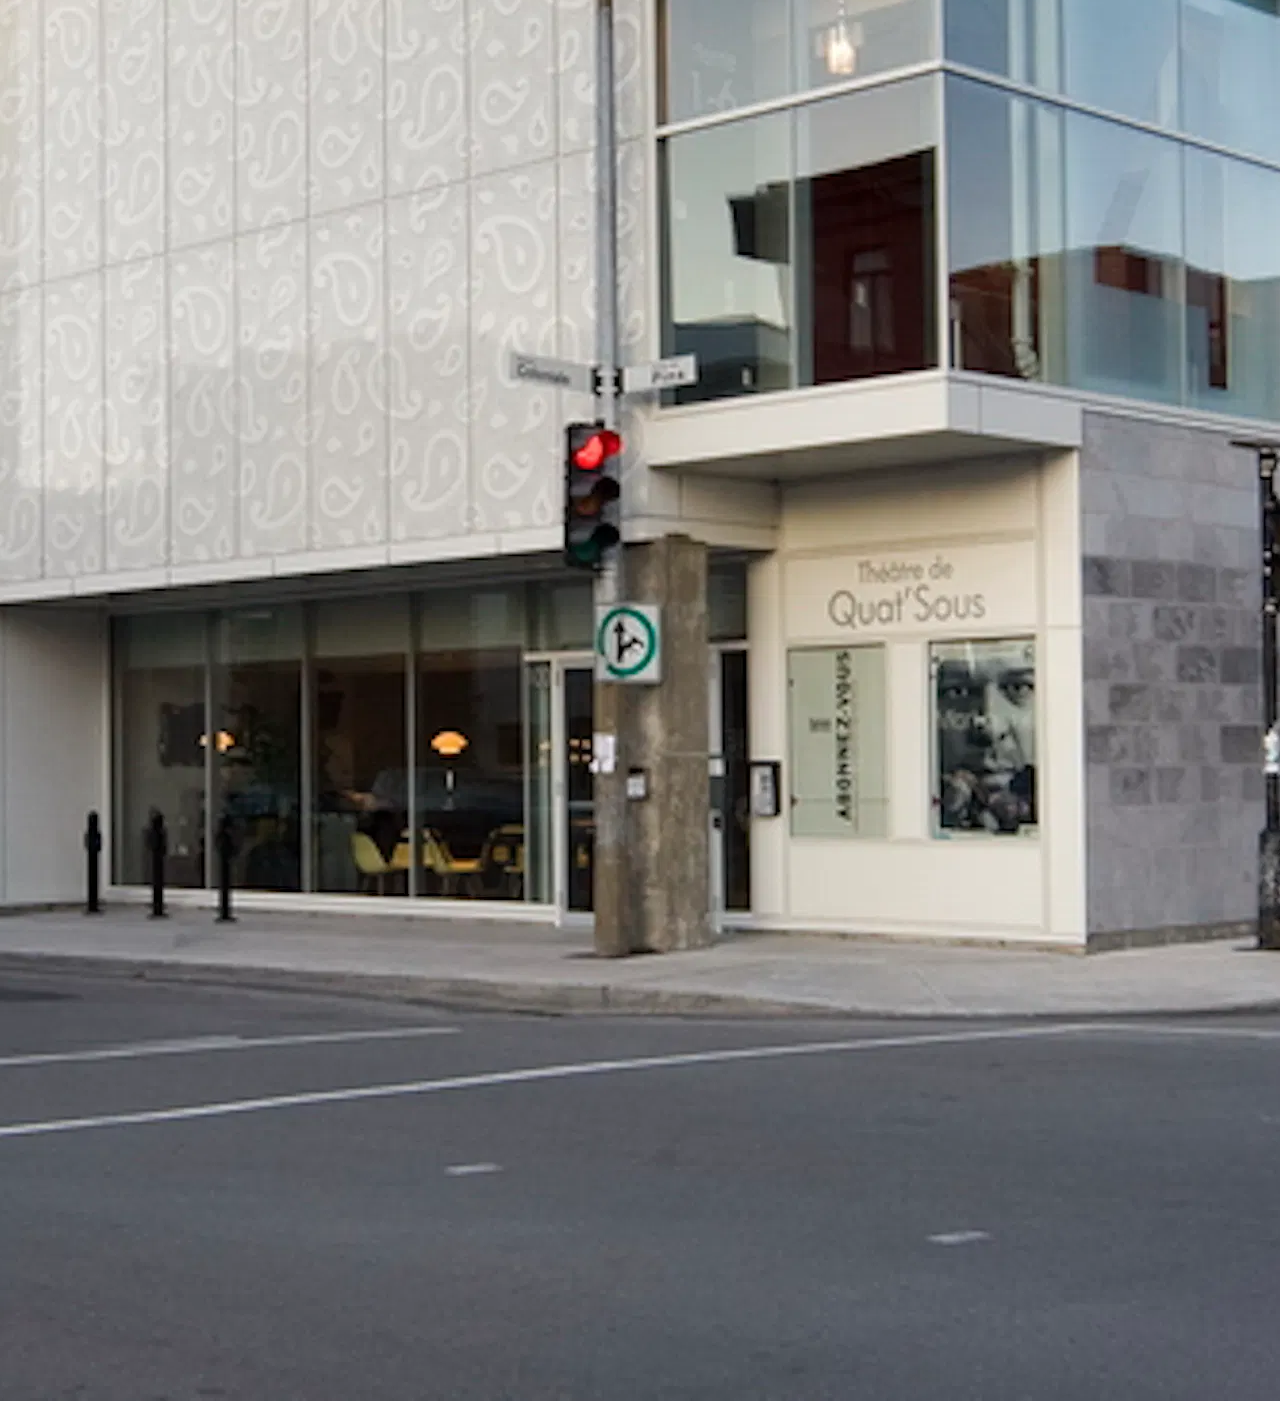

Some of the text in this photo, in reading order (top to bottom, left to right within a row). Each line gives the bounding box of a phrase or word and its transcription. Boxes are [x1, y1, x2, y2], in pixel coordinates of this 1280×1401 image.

[857, 554, 955, 584] Théâtre de
[827, 585, 986, 629] Quat'Sous
[835, 650, 853, 821] ABONNEZ-VOUS
